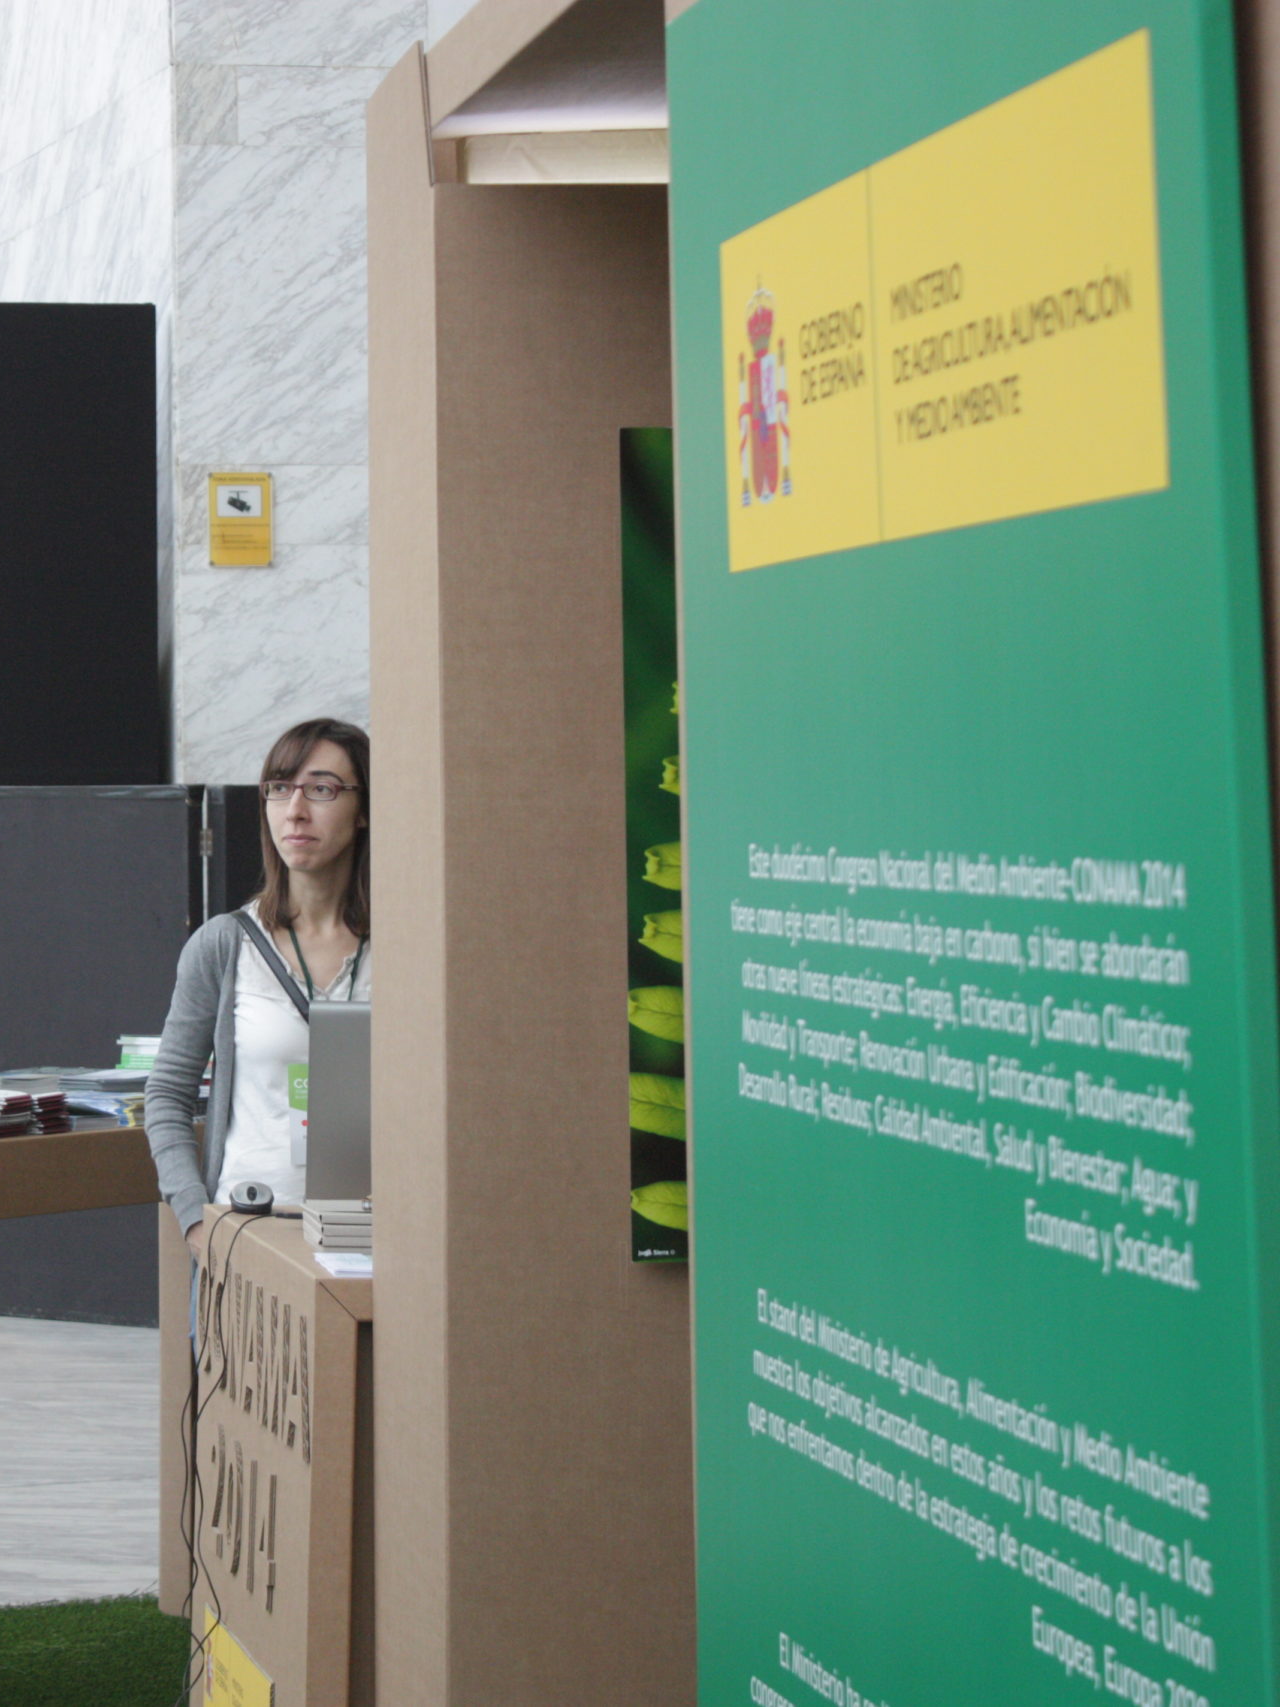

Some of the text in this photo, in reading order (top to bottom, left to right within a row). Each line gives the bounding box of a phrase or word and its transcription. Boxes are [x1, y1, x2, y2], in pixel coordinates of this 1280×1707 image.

[799, 301, 864, 359] GOBIERNO
[889, 261, 962, 324] MINISTERIO
[893, 263, 1132, 385] DE AGRICULTURA, ALIMENTACIÓN
[800, 344, 865, 406] DE ESPAÑA
[894, 374, 1021, 446] Y MEDIO AMBIENTE
[748, 843, 770, 878] Este
[771, 843, 826, 883] duodécimo
[827, 846, 878, 895] Congreso
[879, 850, 932, 891] Nacional
[933, 851, 955, 893] del
[957, 853, 996, 895] Medio
[1141, 860, 1188, 909] 2014
[730, 898, 1190, 986] tiene como eje central la economía baja en carbono, si bien se abordarán
[741, 957, 766, 991] otras
[767, 964, 798, 996] nueve
[798, 958, 832, 1003] líneas
[960, 984, 1029, 1036] Eficiencia
[1029, 1005, 1041, 1048] y
[1042, 995, 1101, 1048] Cambio
[741, 1009, 788, 1052] Movilidad
[788, 1026, 796, 1062] y
[859, 1030, 926, 1080] Renovación
[927, 1043, 976, 1092] Urbana
[976, 1063, 988, 1104] y
[738, 1062, 787, 1108] Desarrollo
[874, 1094, 921, 1142] Calidad
[993, 1121, 1035, 1174] Salud
[1035, 1143, 1047, 1185] y
[1183, 1178, 1200, 1228] y
[1024, 1197, 1202, 1292] Economía y Sociedad.
[199, 1246, 311, 1465] CONAMA
[757, 1287, 1211, 1521] El stand del Ministerio de Agricultura, Alimentación y Medio Ambiente
[211, 1424, 278, 1614] 2014
[752, 1349, 1214, 1598] muestra los objetivos alcanzados en estos años y los retos futuros a los
[747, 1401, 1216, 1673] que nos enfrentamos dentro de la estrategia de crecimiento de la Unión
[779, 1632, 790, 1670] El
[791, 1640, 844, 1707] Ministerio
[1031, 1604, 1102, 1690] Europea,
[1103, 1643, 1164, 1707] Europa
